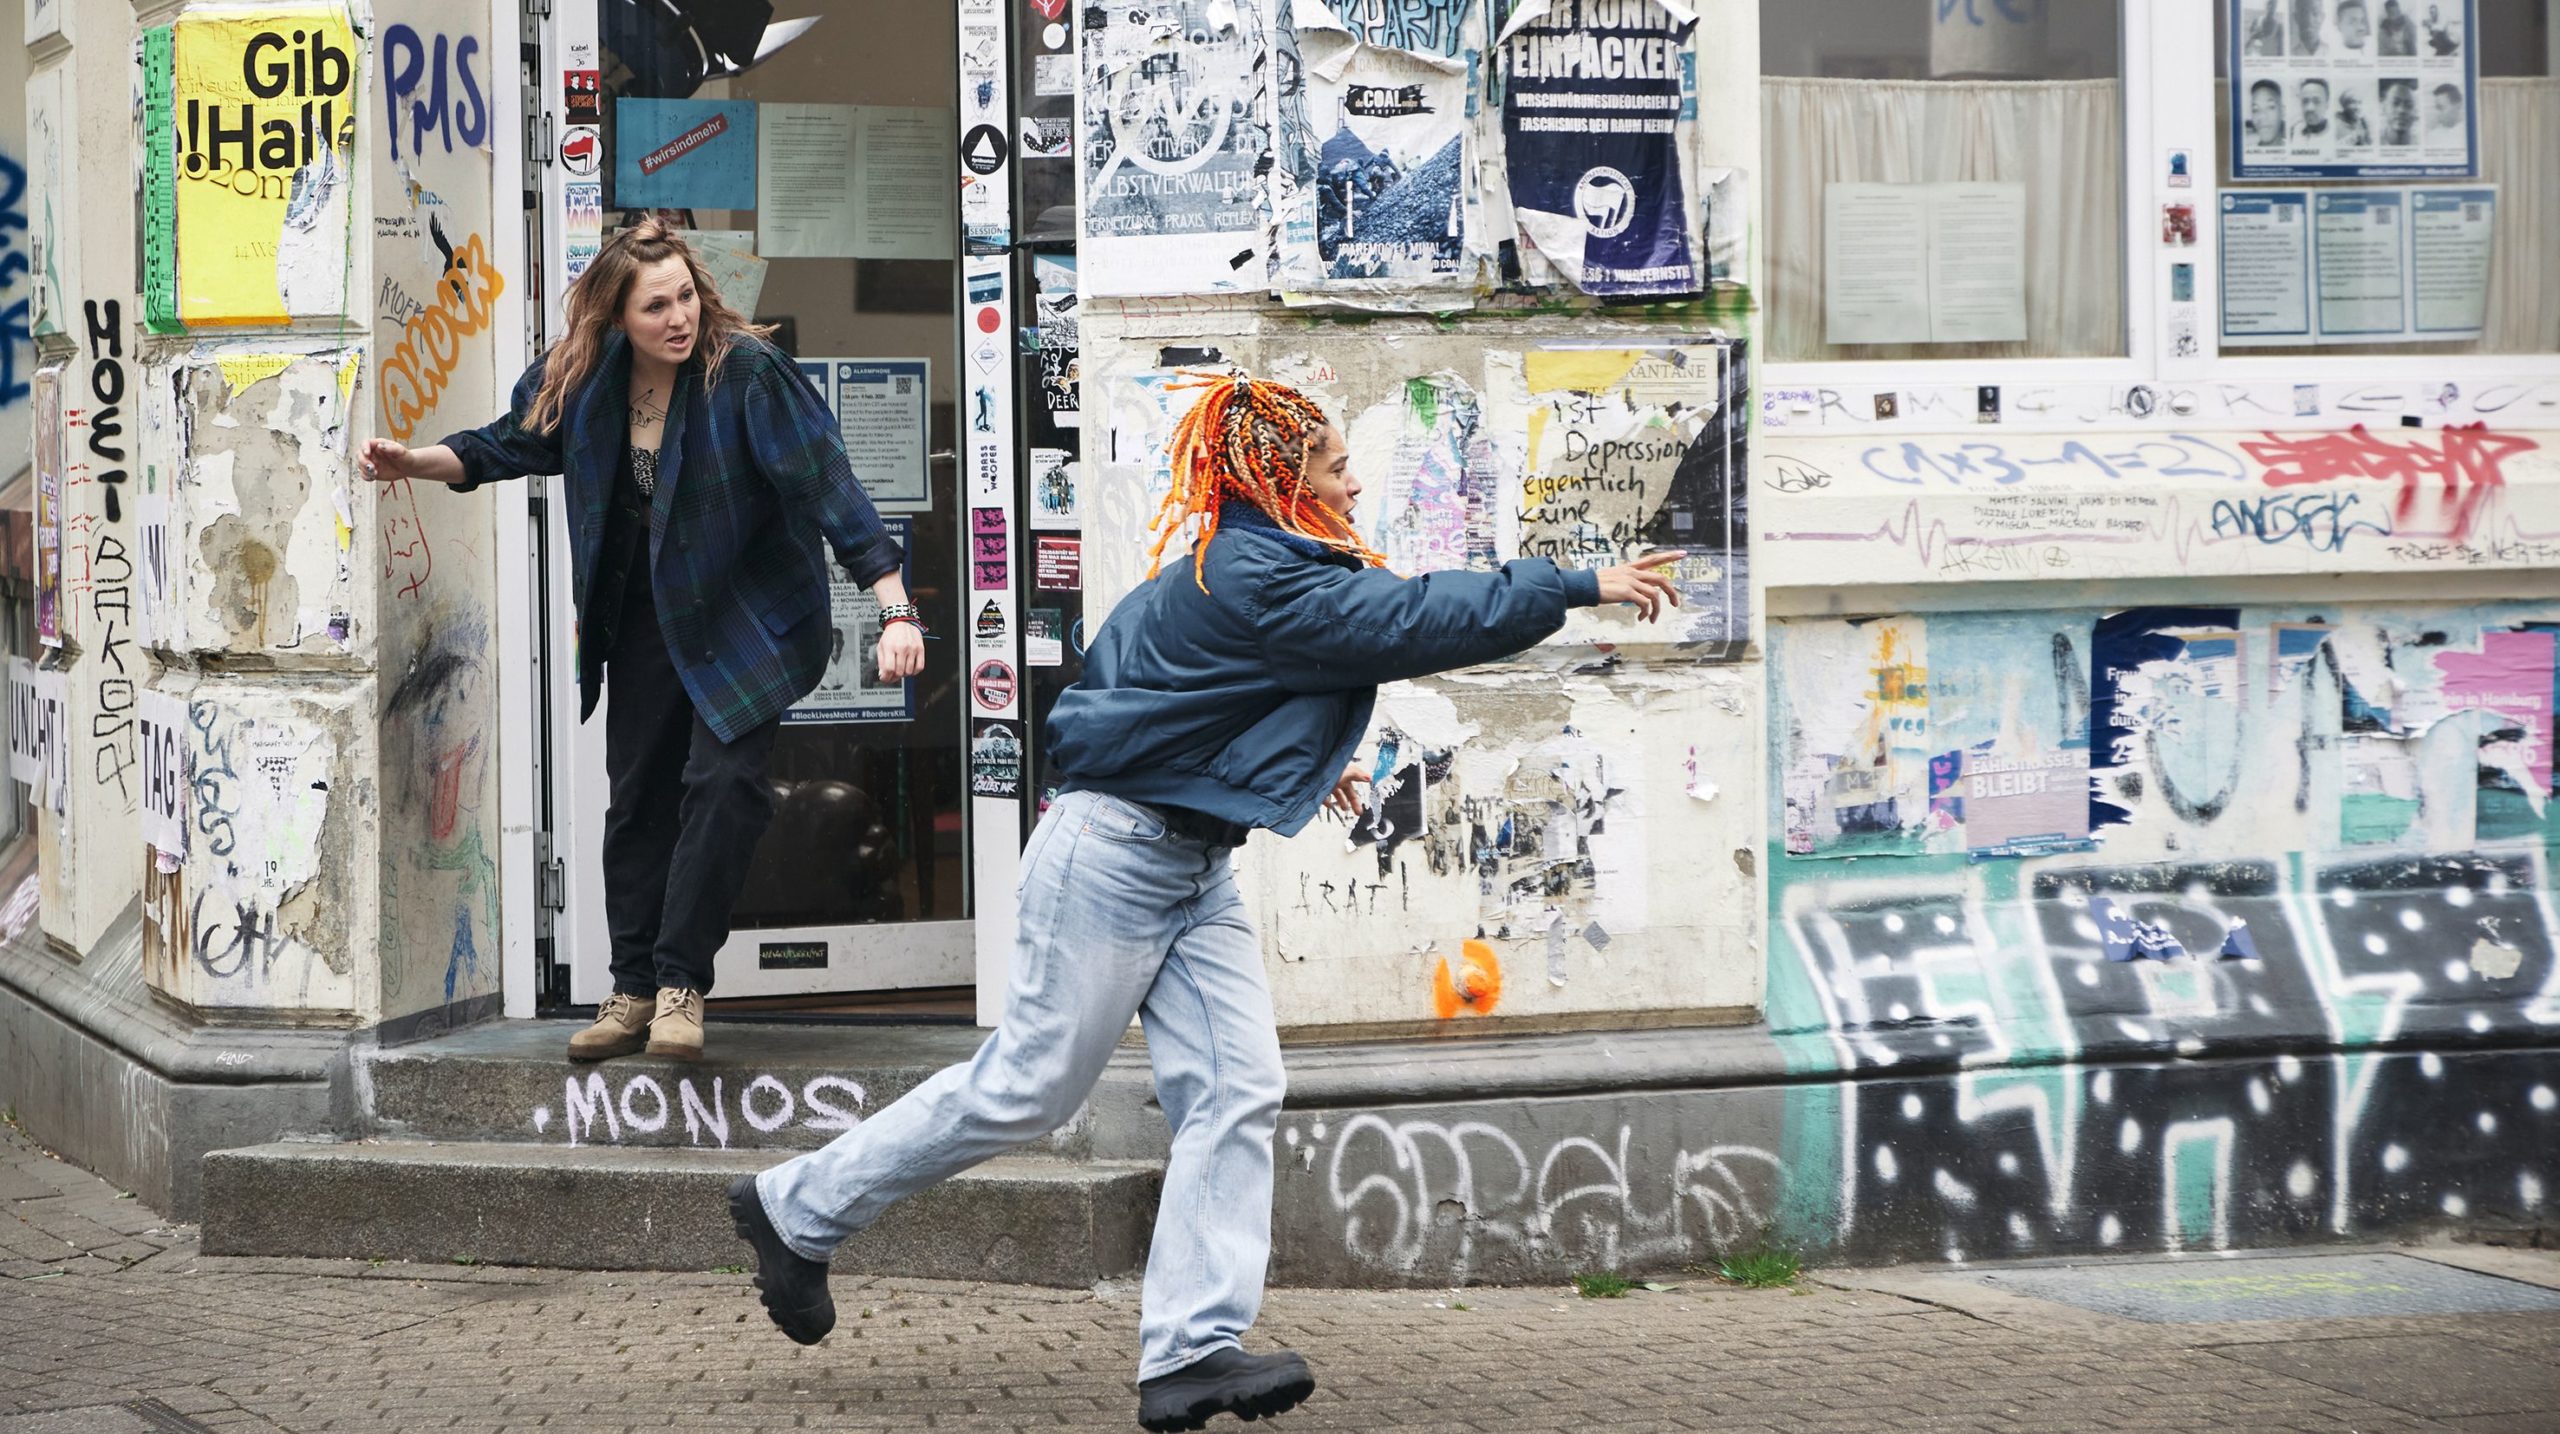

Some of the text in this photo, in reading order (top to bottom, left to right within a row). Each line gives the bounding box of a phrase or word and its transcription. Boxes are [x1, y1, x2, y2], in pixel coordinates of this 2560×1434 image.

[243, 29, 350, 99] Gib
[383, 24, 488, 166] PMS
[1516, 91, 1669, 110] VERSCHWÖRUNGSIDEOLOGIEN
[1520, 117, 1588, 132] FASCHISMUS
[1610, 118, 1643, 134] RAUM
[1643, 118, 1675, 134] NEHM
[644, 120, 722, 170] #wirsindmehr
[969, 226, 1003, 235] SESSION
[1564, 430, 1689, 469] Depression
[1522, 466, 1646, 501] eigentlich
[1685, 557, 1712, 568] 2021
[1685, 583, 1715, 593] FLORA
[2481, 691, 2542, 710] Hamburg
[862, 710, 906, 719] #BordersKill
[1890, 717, 1926, 737] weg
[140, 719, 176, 819] TAG
[1972, 771, 2050, 800] BLEIBT
